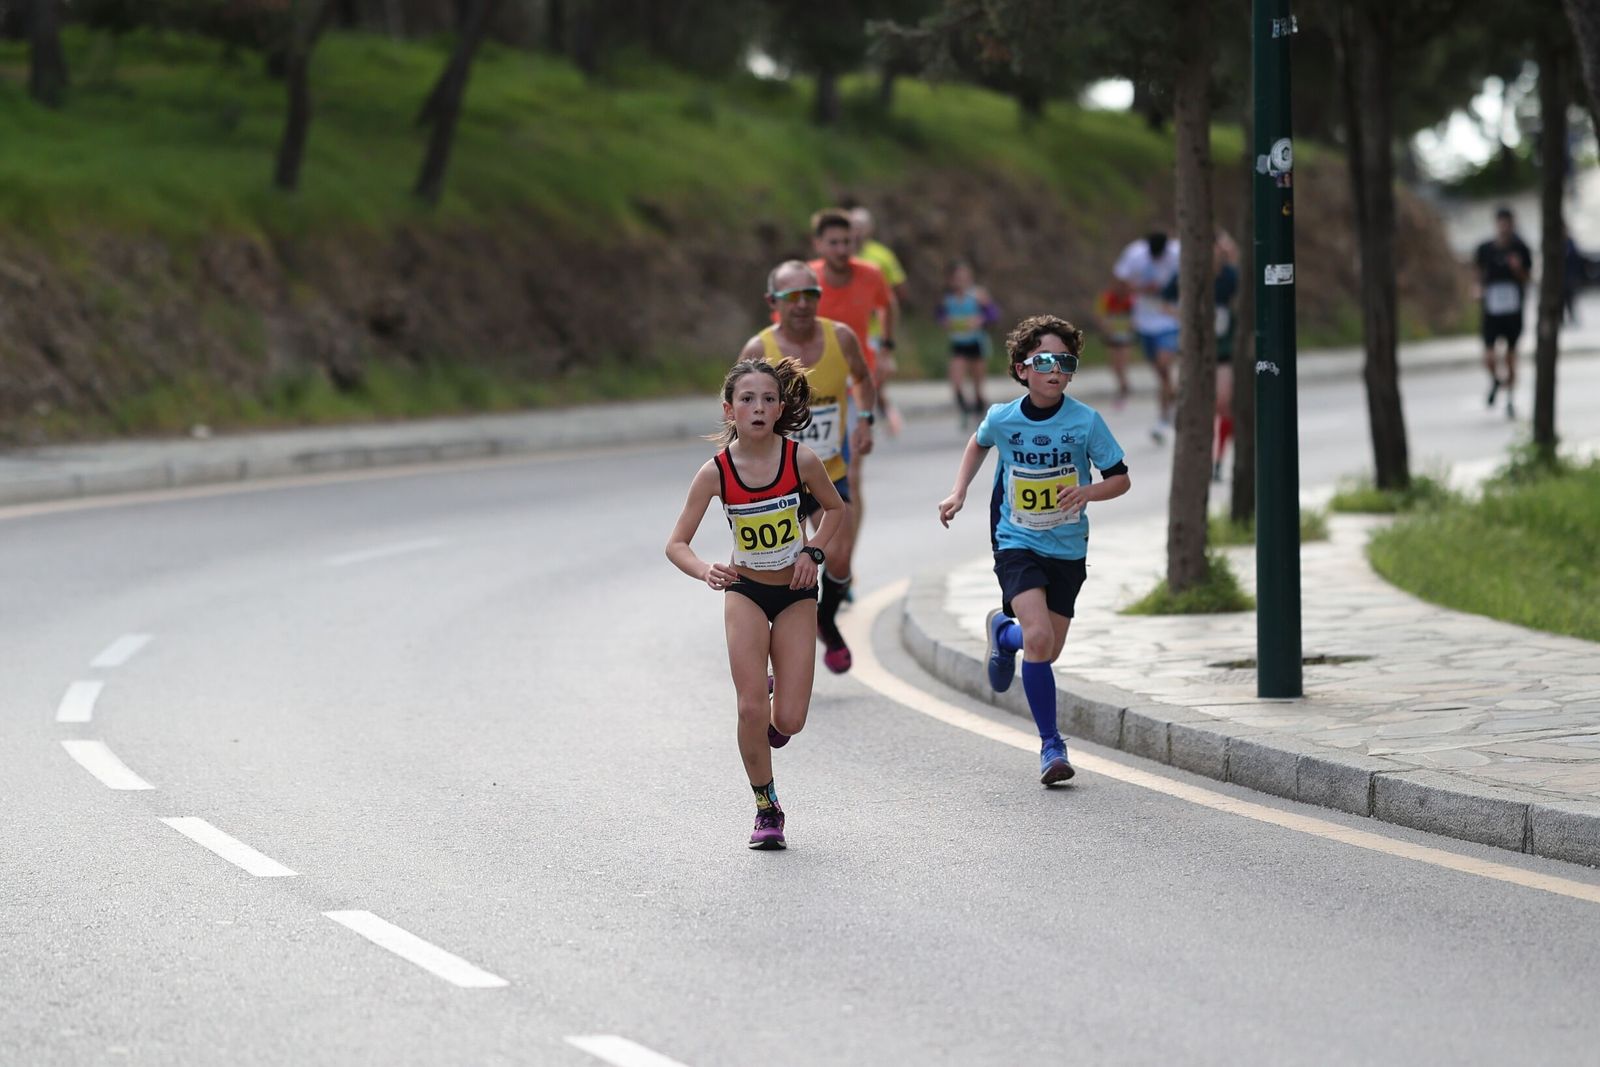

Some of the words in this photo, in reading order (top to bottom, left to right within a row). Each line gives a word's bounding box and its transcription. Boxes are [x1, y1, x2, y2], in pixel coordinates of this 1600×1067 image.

[1012, 447, 1072, 468] nerja
[1021, 488, 1064, 510] 91
[740, 518, 795, 550] 902
